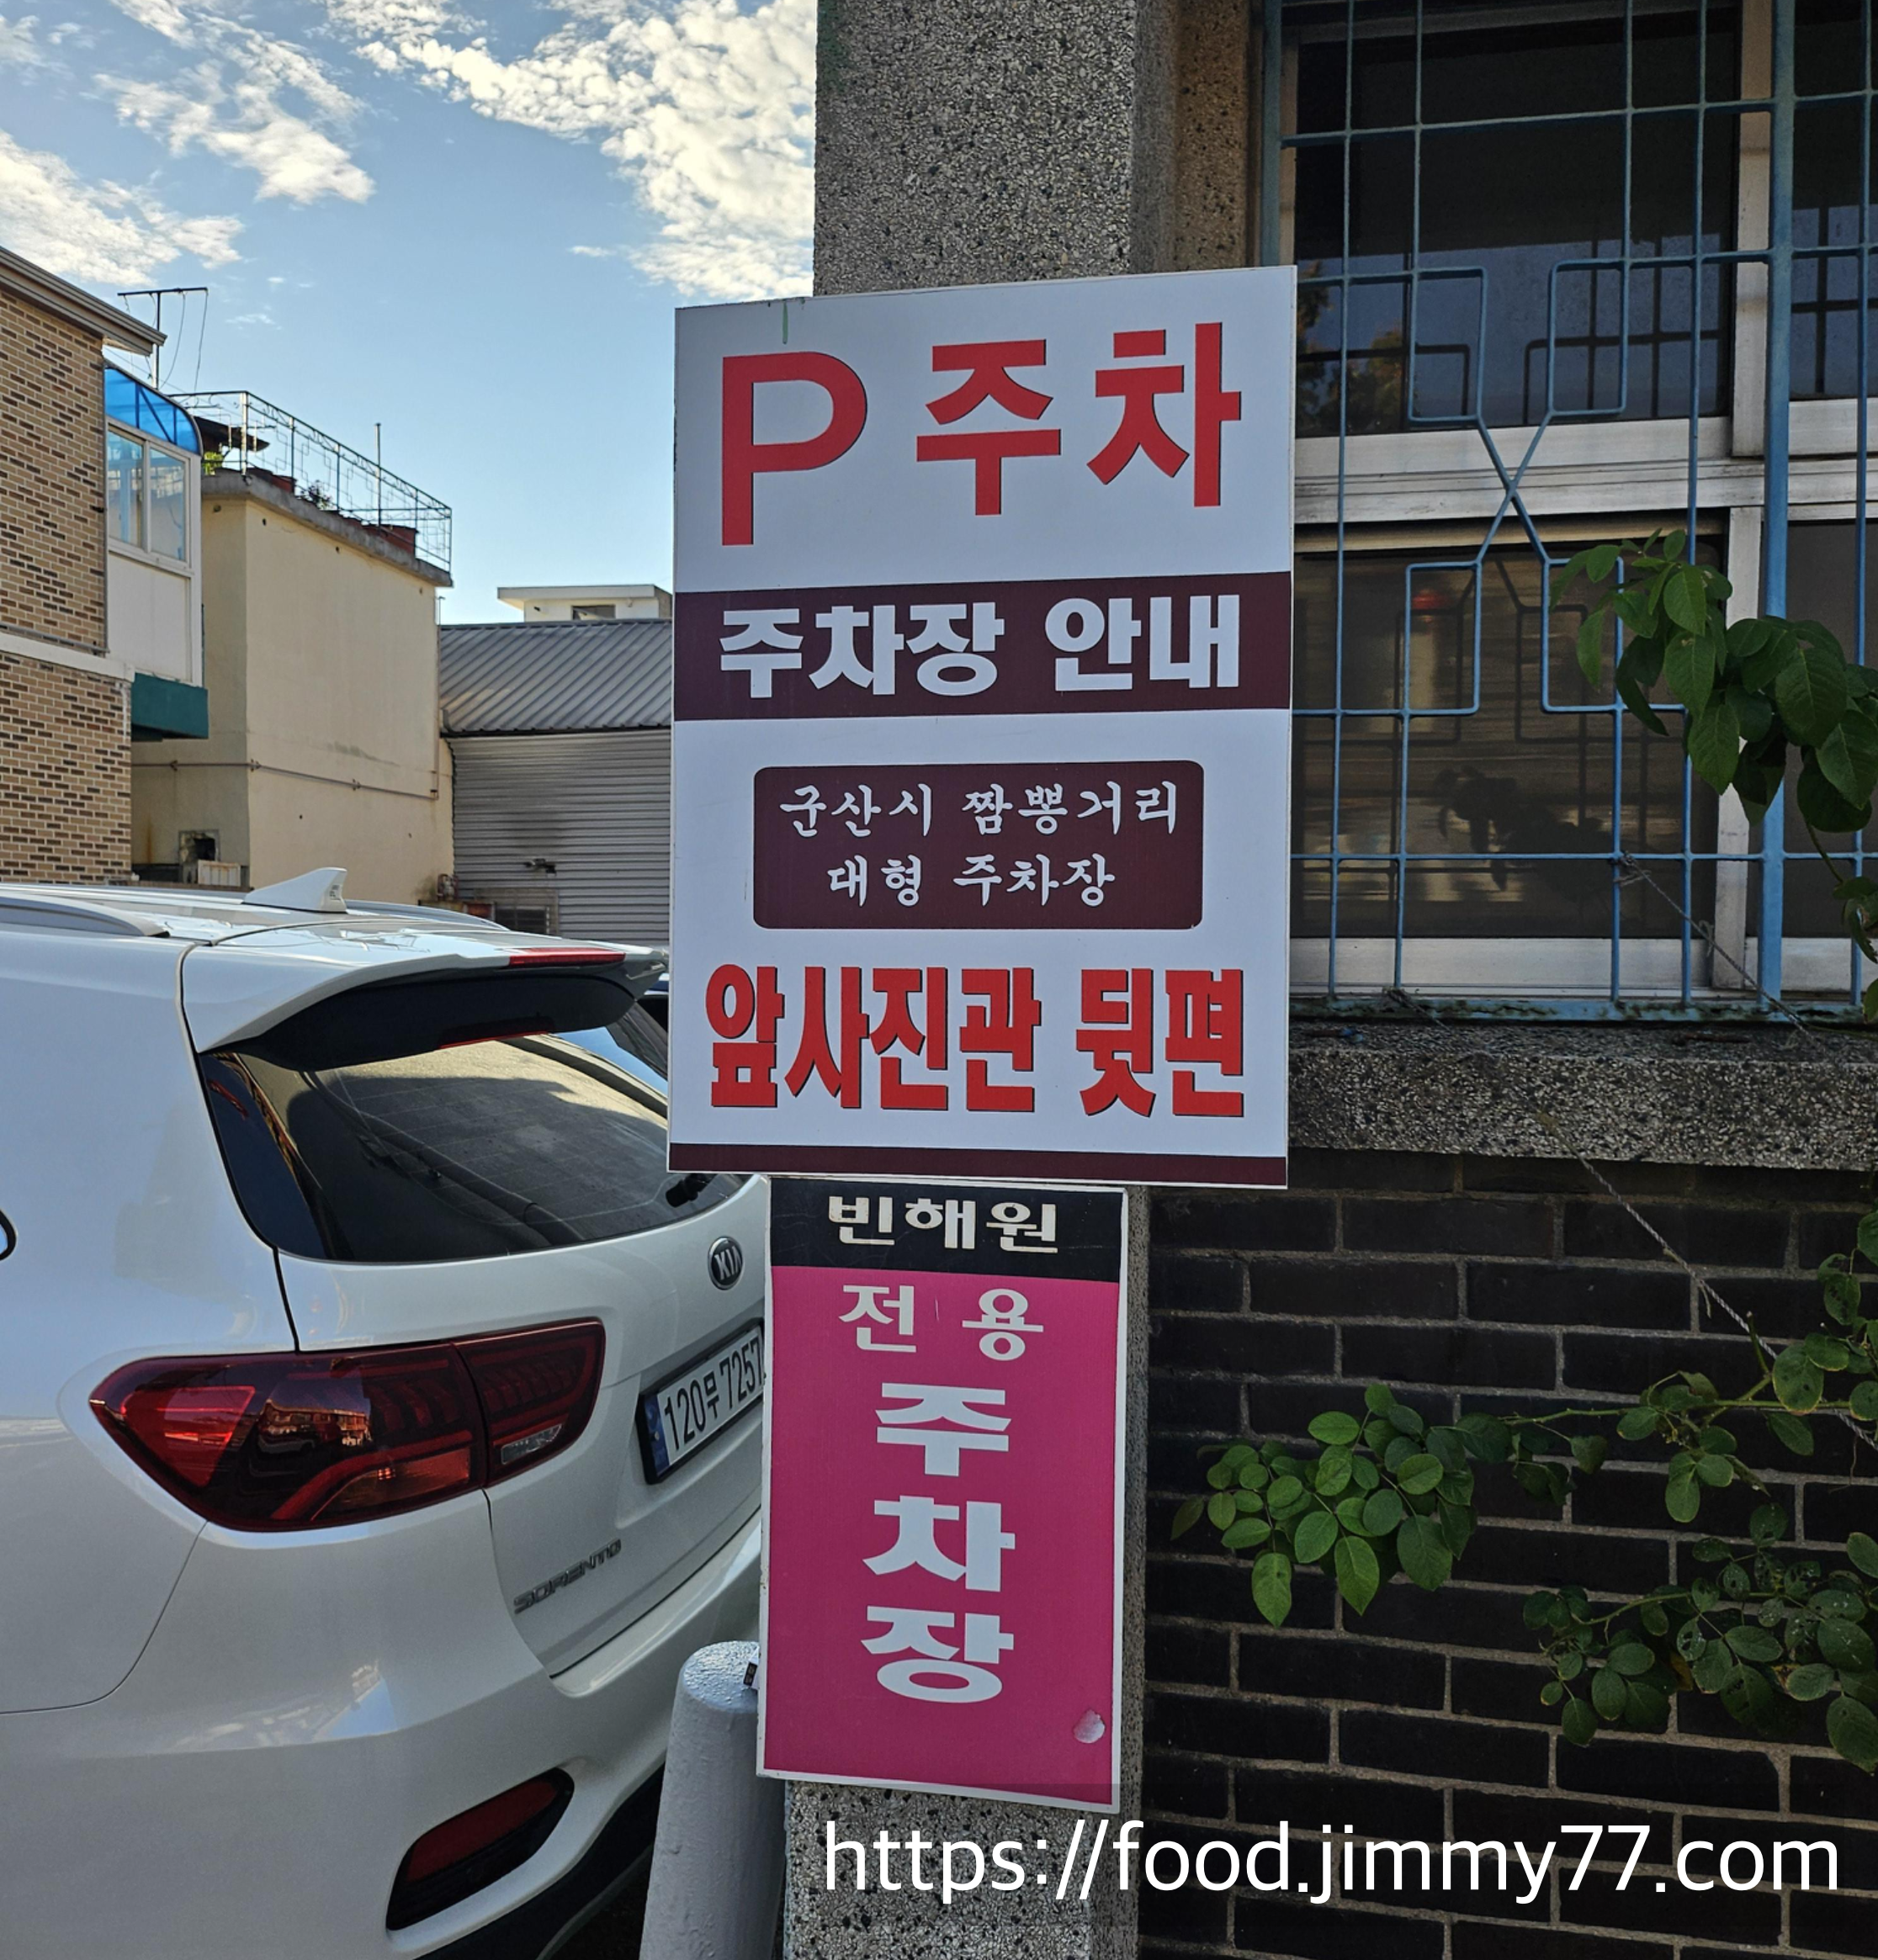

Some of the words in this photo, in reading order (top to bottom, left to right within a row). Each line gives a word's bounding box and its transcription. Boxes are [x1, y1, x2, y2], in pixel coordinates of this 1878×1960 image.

[722, 351, 867, 546] P
[916, 321, 1241, 516] 주차
[719, 601, 1005, 699] 주차장
[1043, 594, 1241, 692] 안내
[779, 783, 933, 838] 군산시
[962, 780, 1179, 836] 짬뽕거리
[827, 853, 924, 907] 대형
[952, 853, 1116, 907] 주차장
[705, 963, 1042, 1112] 앞사진관
[1075, 967, 1244, 1119] 뒷편
[828, 1195, 1059, 1254] 빈해원
[714, 1245, 742, 1280] KIA
[513, 1538, 622, 1615] SORENTO
